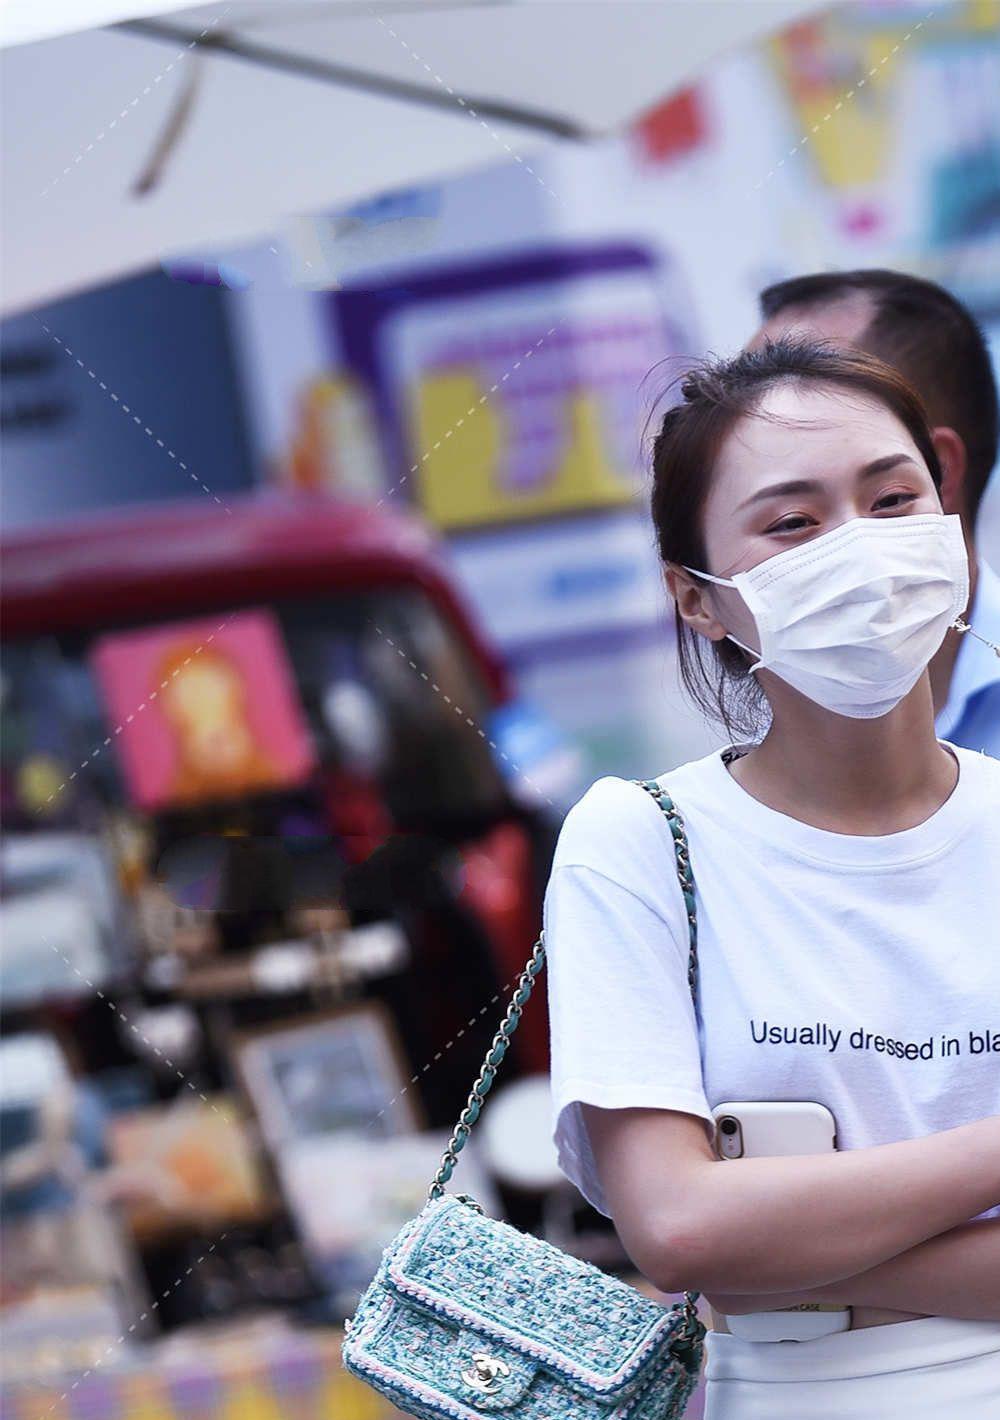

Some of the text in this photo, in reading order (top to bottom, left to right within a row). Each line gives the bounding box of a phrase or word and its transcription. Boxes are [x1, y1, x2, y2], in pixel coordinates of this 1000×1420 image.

[750, 1019, 842, 1053] Usually
[849, 1027, 934, 1060] dressed
[940, 1034, 960, 1057] in
